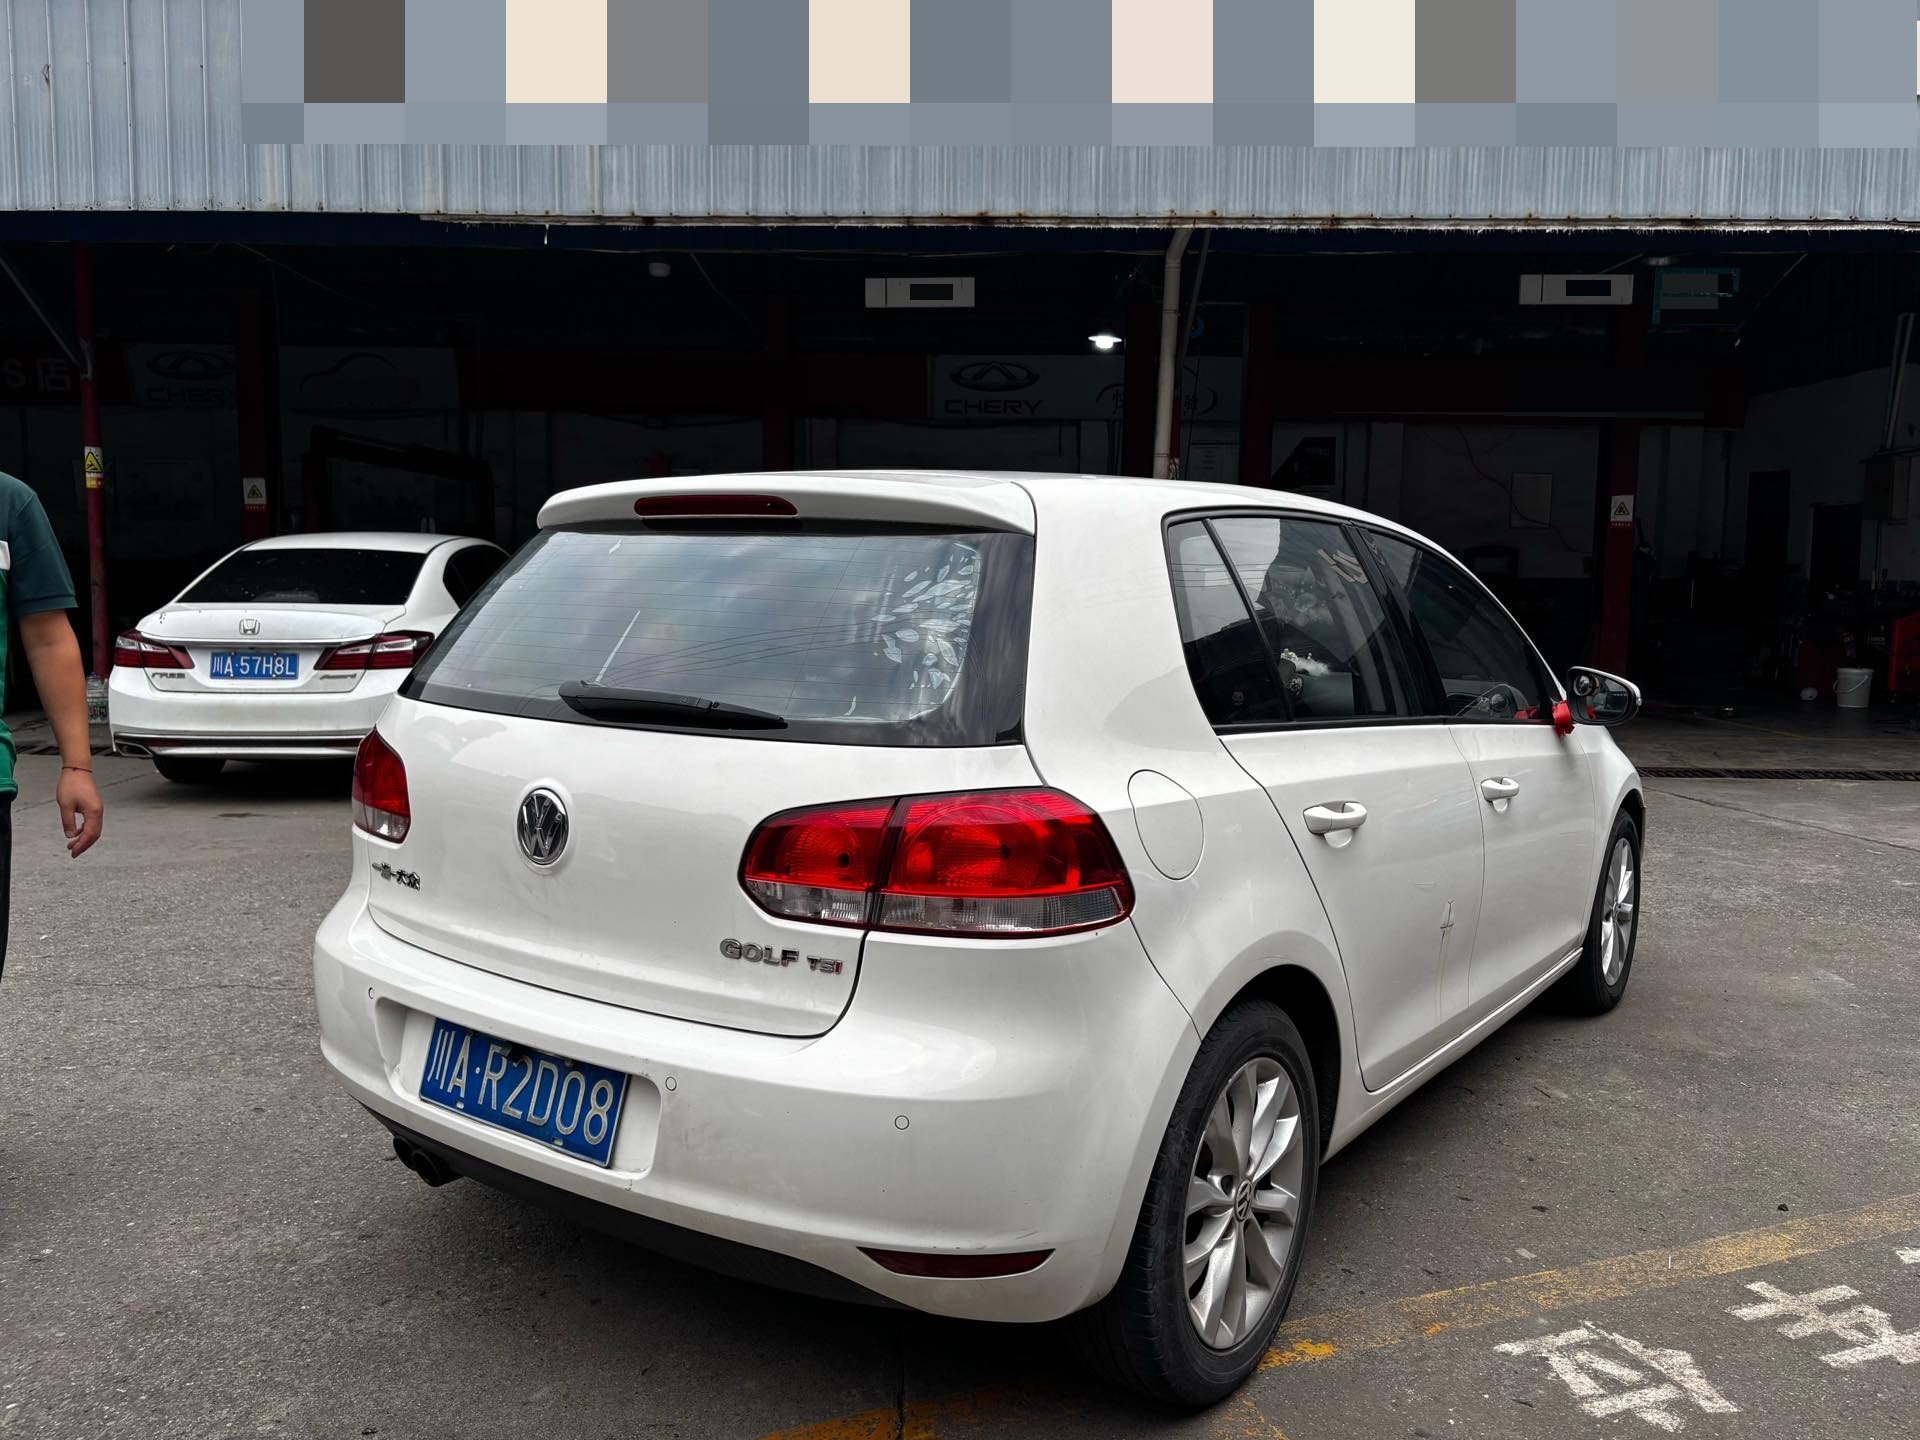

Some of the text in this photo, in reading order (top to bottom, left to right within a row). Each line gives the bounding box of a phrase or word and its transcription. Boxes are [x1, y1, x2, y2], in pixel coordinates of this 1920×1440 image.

[944, 399, 1042, 414] CHERY
[212, 655, 296, 676] 川A·57H8L
[719, 937, 843, 975] GOLF TSI
[426, 1028, 614, 1146] 川A·R2D08
